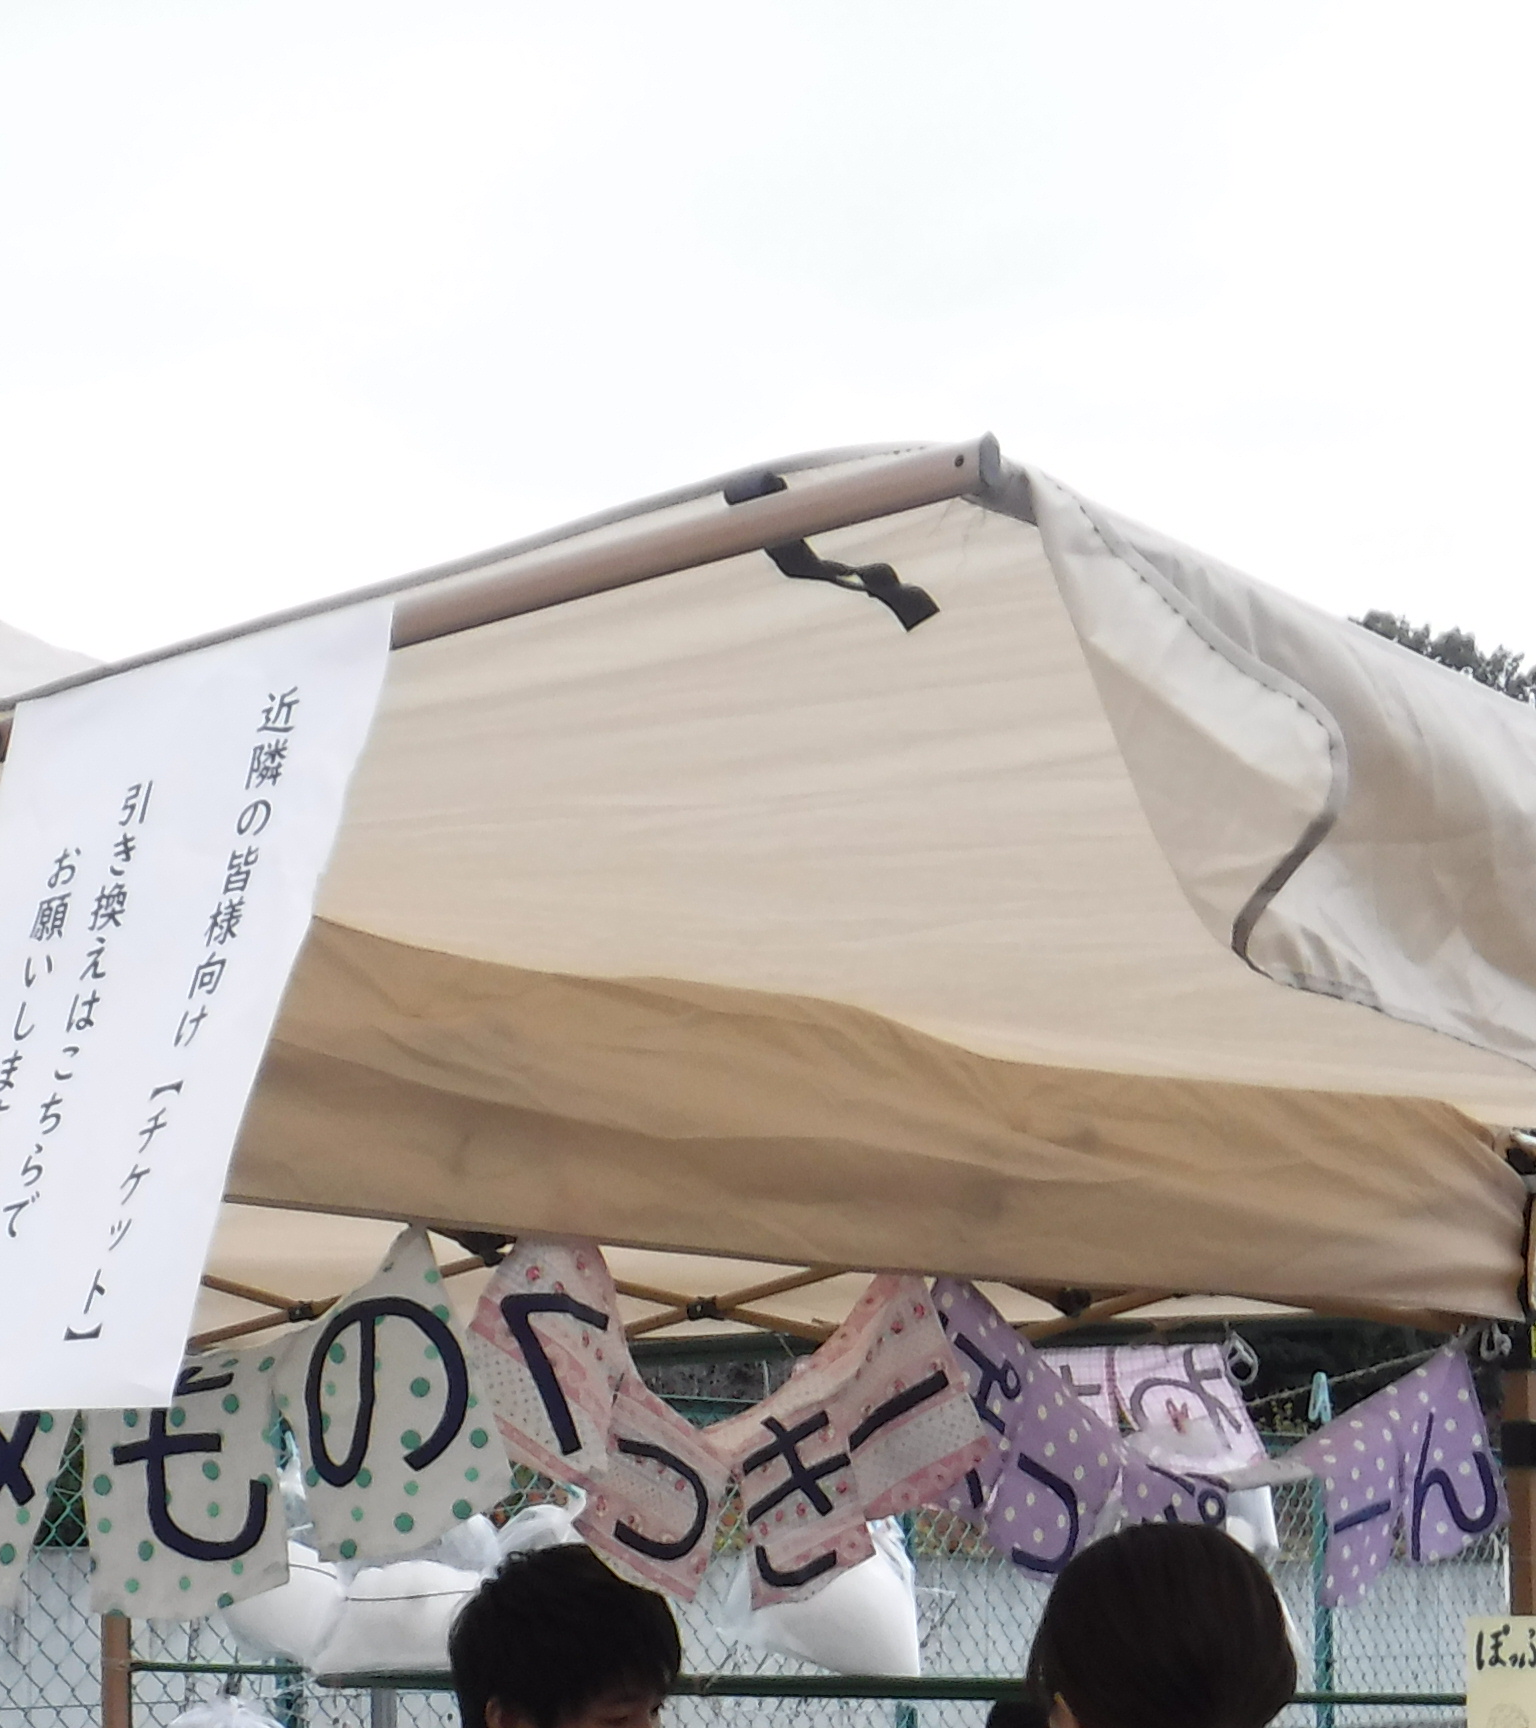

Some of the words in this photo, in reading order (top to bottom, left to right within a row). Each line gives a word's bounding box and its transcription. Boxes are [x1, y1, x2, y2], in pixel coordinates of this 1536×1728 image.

[3, 781, 153, 1239] 引き換えはこちらで
